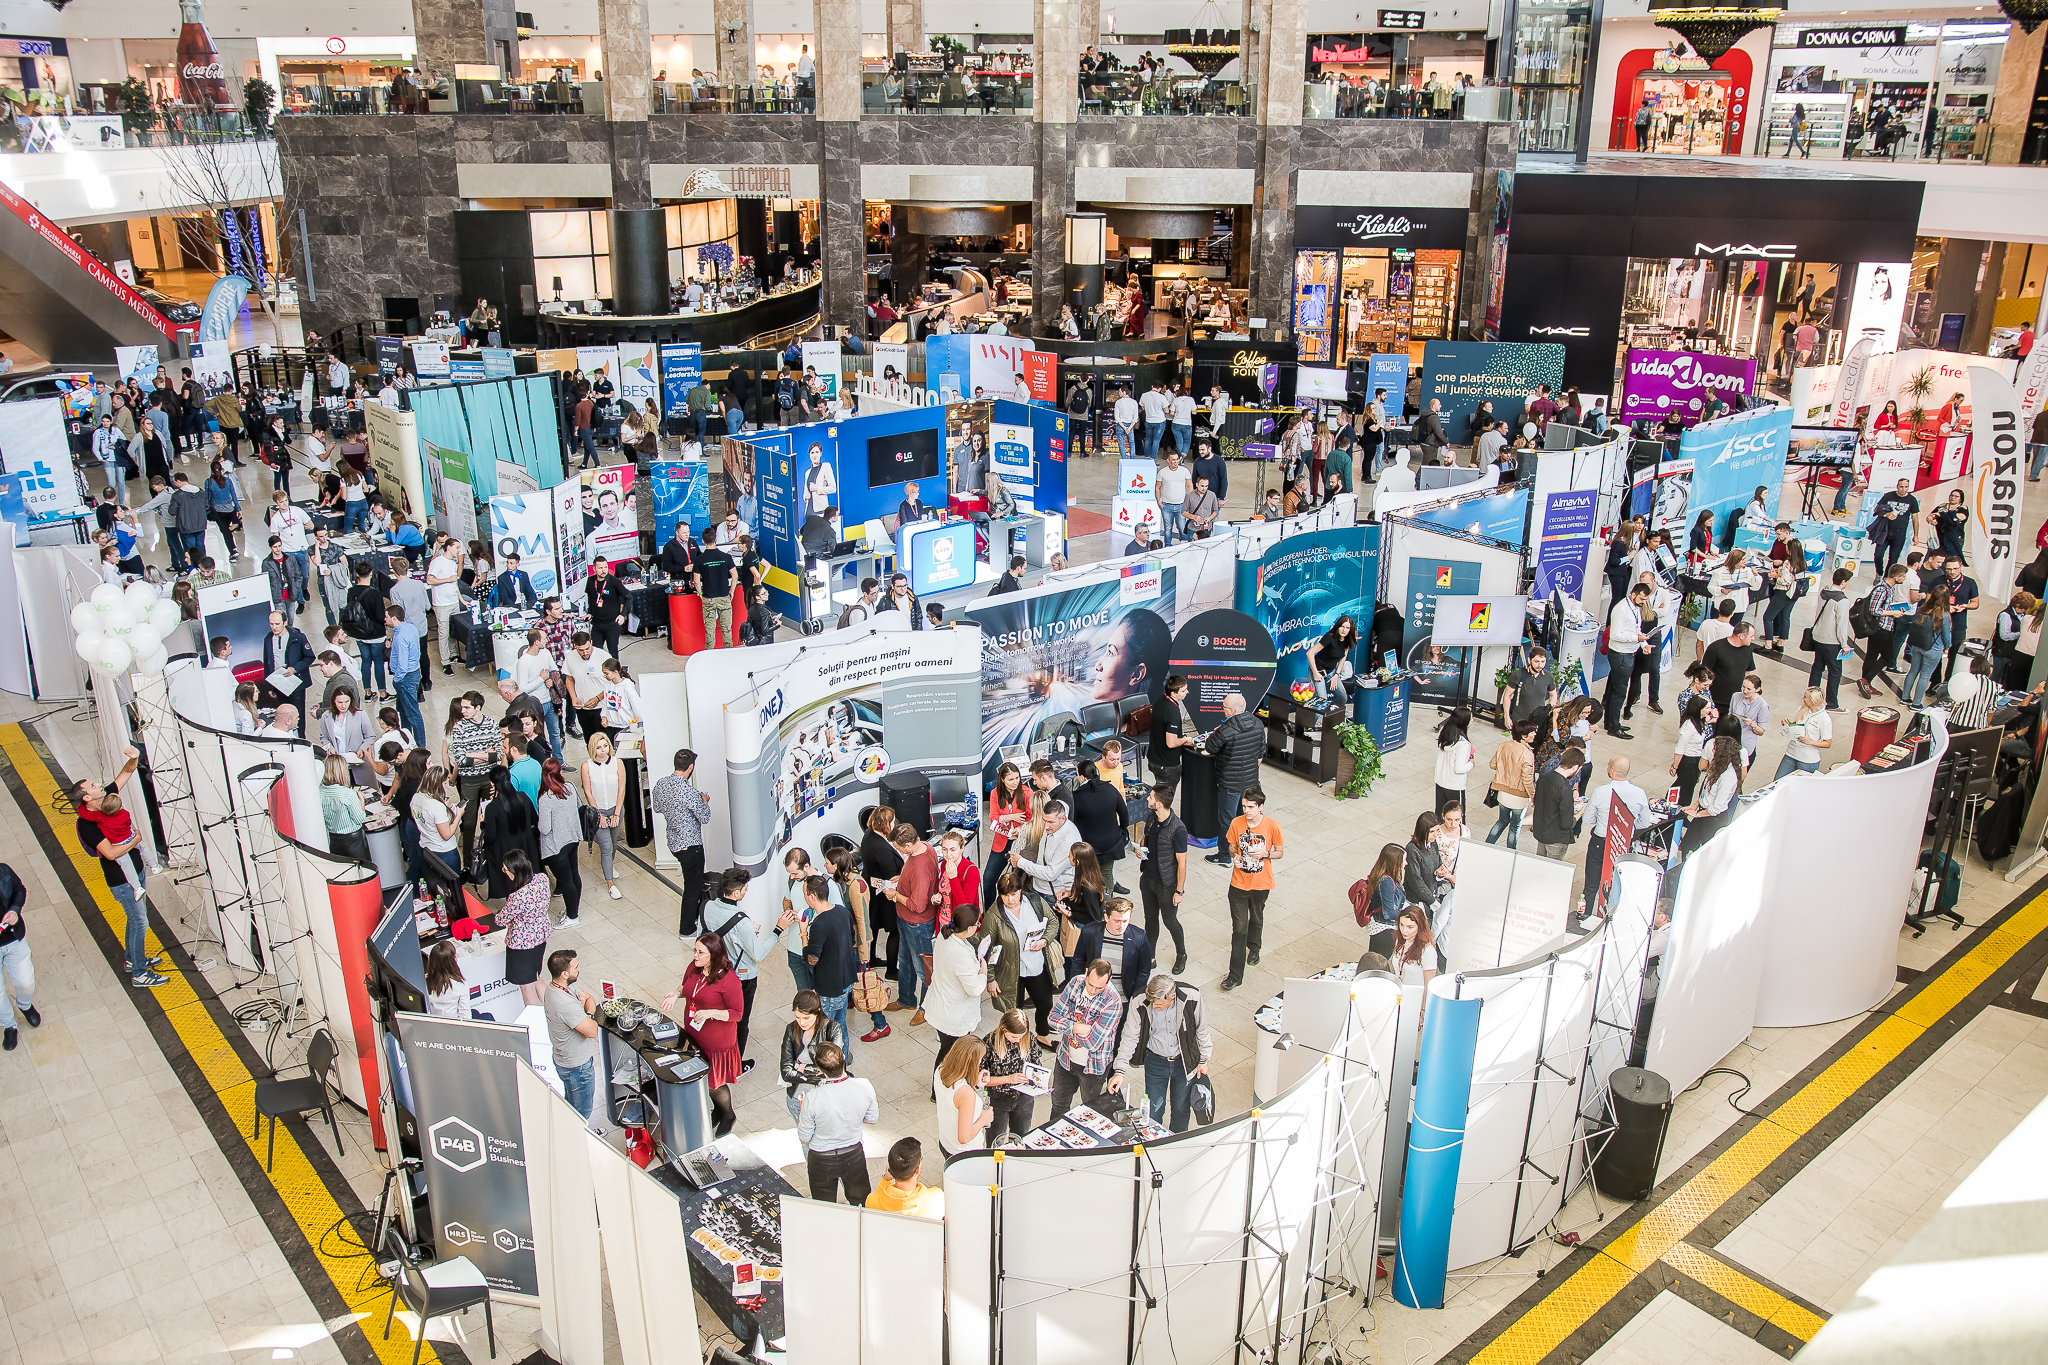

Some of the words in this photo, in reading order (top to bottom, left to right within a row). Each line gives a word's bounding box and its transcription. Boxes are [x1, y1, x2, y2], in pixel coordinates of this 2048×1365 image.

[1805, 32, 1850, 46] DONNA
[1852, 29, 1896, 44] CARINA
[1863, 67, 1888, 75] DONNA
[1892, 67, 1919, 75] CARINA
[731, 167, 746, 191] LA
[748, 167, 791, 191] CUPOLA
[1351, 214, 1410, 235] Kiehl's
[41, 225, 63, 246] REGINA
[63, 243, 82, 261] MARIA
[87, 262, 127, 301] CAMPUS
[128, 295, 167, 335] MEDICAL
[212, 280, 238, 332] CARIERE
[1234, 350, 1267, 369] Coffee
[665, 371, 701, 379] Leadership
[1233, 368, 1259, 377] POIN
[1435, 374, 1456, 382] one
[1460, 372, 1508, 384] platform
[1510, 374, 1527, 384] for
[1631, 356, 1745, 393] vidaXL.com
[623, 385, 657, 397] BEST
[1434, 384, 1447, 394] all
[1449, 384, 1482, 396] junior
[1485, 385, 1536, 398] develope
[903, 452, 912, 460] LG
[1730, 459, 1740, 471] We
[1741, 457, 1756, 468] make
[1756, 456, 1762, 464] IT
[1762, 454, 1774, 463] work
[1279, 551, 1303, 565] EUROPEAN
[1303, 547, 1327, 558] LEADER
[1292, 554, 1332, 567] TECHNOLOGY
[1332, 549, 1378, 561] CONSULTING
[1134, 578, 1157, 590] BOSCH
[980, 625, 1043, 650] PASSION
[1046, 620, 1065, 636] TO
[1070, 610, 1109, 632] MOVE
[980, 652, 1004, 663] Shape
[1007, 640, 1052, 657] tomorrow's
[1053, 635, 1075, 647] world
[1213, 637, 1247, 646] BOSCH
[818, 660, 844, 677] Soluții
[846, 654, 877, 670] pentru
[880, 647, 911, 660] mașini
[989, 671, 1011, 682] among
[1012, 667, 1021, 675] the
[1022, 665, 1034, 673] first
[1042, 659, 1055, 668] take
[992, 661, 1011, 671] future
[1012, 656, 1030, 666] offers
[829, 676, 841, 686] din
[843, 668, 877, 682] respect
[880, 661, 911, 675] pentru
[914, 658, 953, 668] oameni
[414, 1040, 428, 1048] WE
[429, 1042, 444, 1050] ARE
[458, 1045, 473, 1053] THE
[474, 1047, 495, 1056] SAME
[495, 1050, 515, 1058] PAGE
[439, 1137, 476, 1153] P4B
[487, 1136, 518, 1149] People
[488, 1145, 502, 1153] for
[449, 1230, 466, 1238] NRS
[500, 1236, 513, 1246] QA
